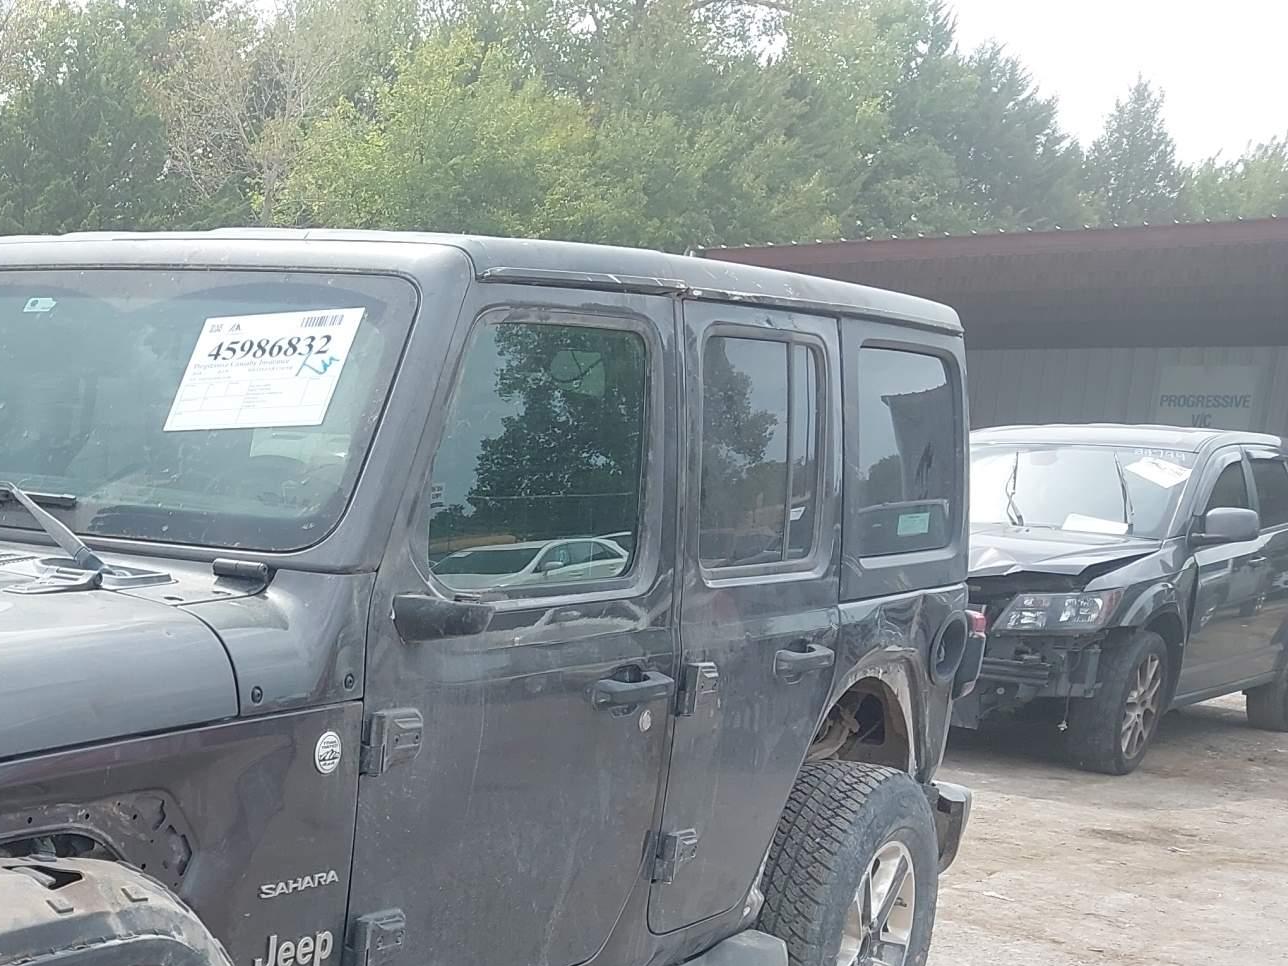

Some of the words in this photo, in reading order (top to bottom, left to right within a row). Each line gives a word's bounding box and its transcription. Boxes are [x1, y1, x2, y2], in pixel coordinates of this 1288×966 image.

[208, 335, 333, 361] 45986832
[1160, 393, 1252, 408] PROGRESSIVE
[259, 870, 339, 899] SAHARA
